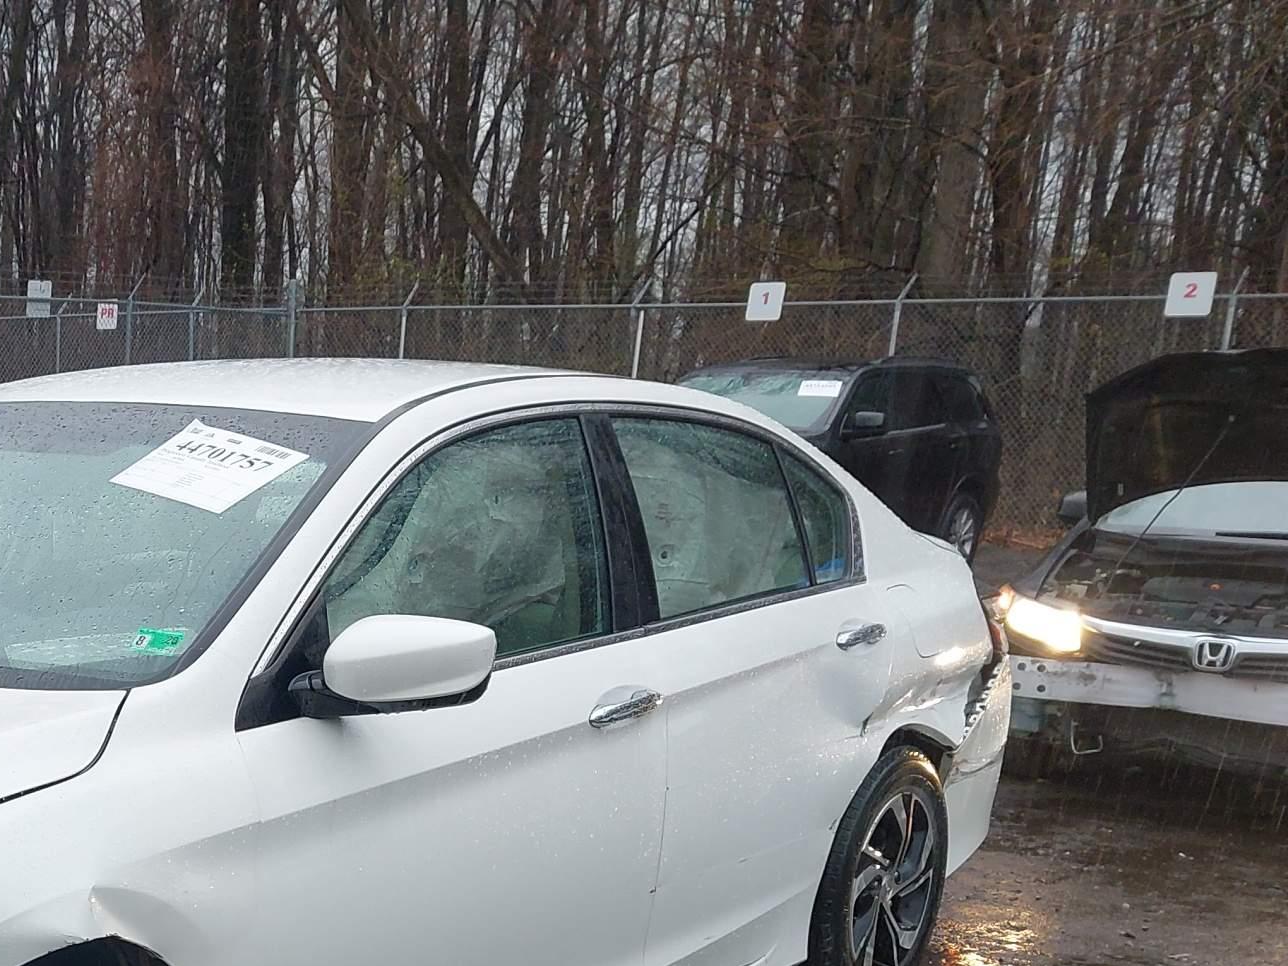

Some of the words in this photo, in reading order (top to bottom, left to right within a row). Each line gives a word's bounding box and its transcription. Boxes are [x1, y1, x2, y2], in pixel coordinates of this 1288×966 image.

[762, 291, 770, 305] 1
[1183, 282, 1198, 298] 2
[175, 440, 274, 472] 44701757
